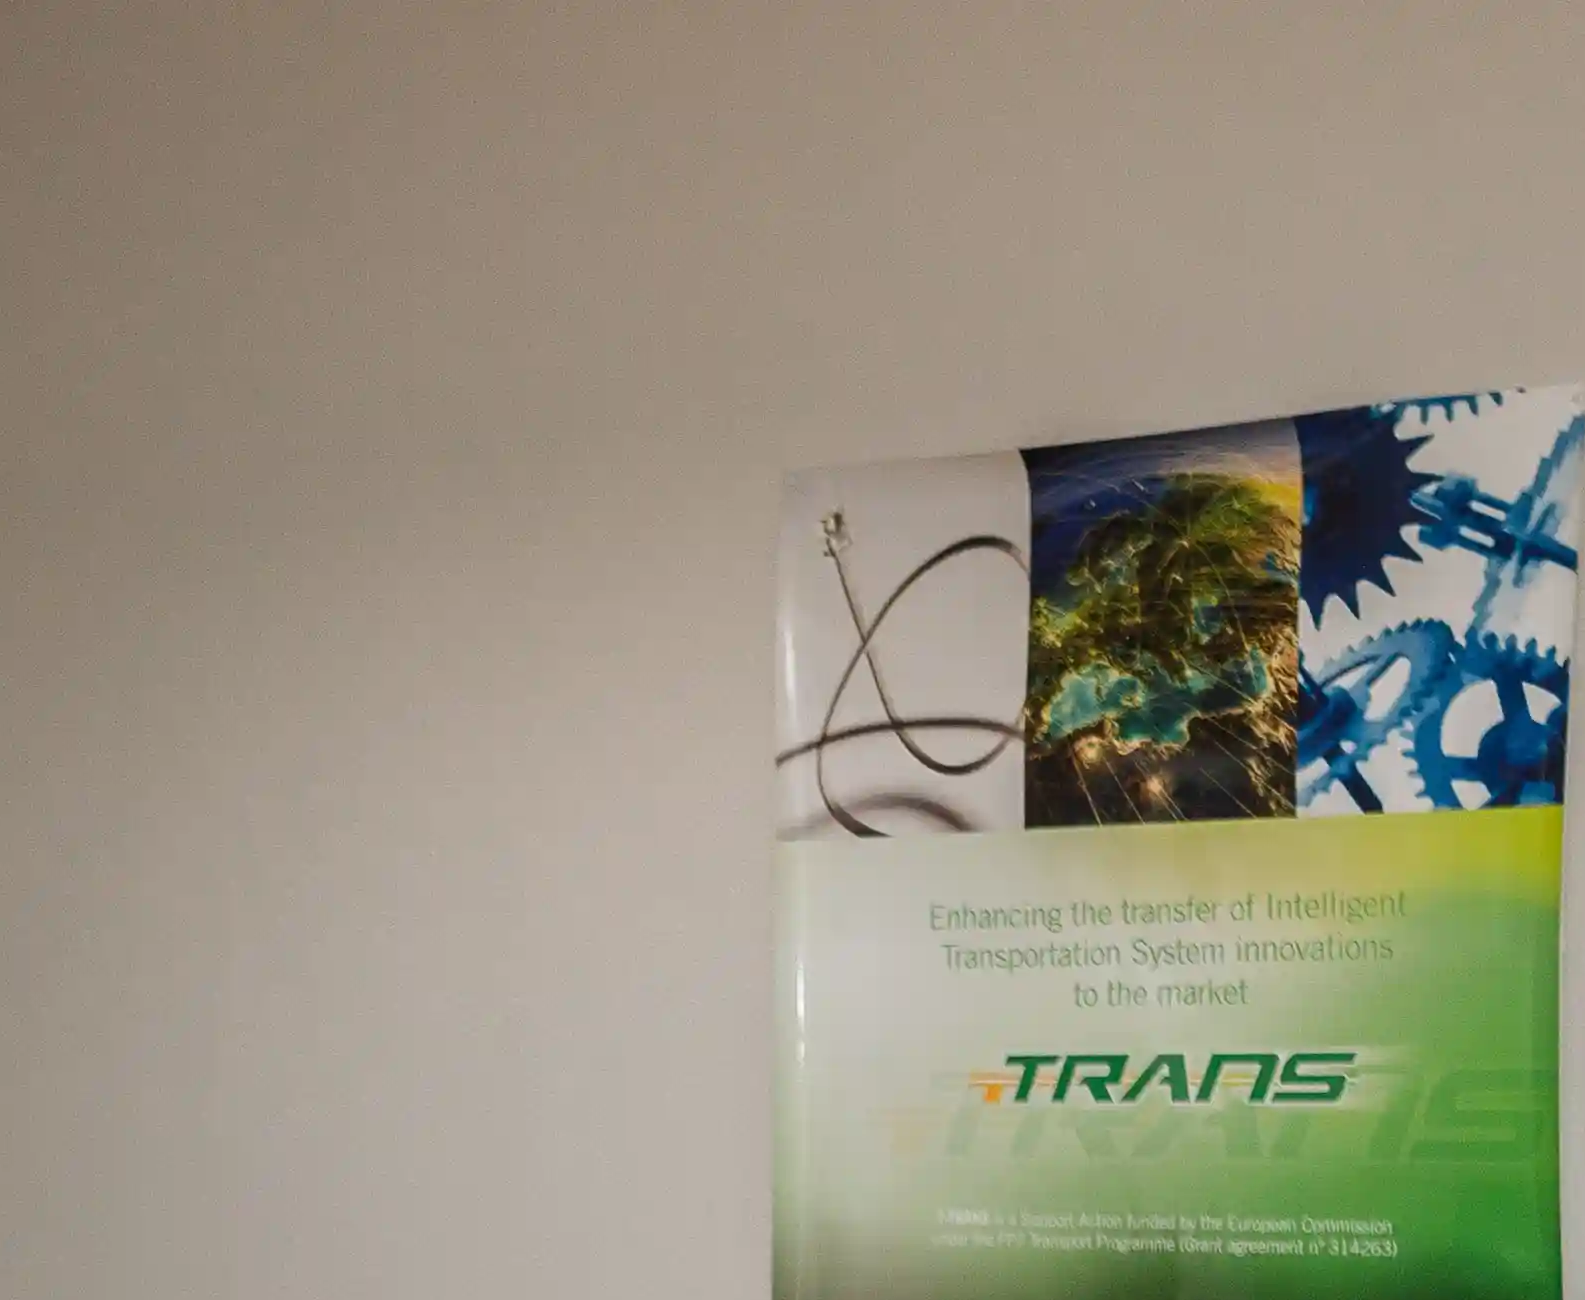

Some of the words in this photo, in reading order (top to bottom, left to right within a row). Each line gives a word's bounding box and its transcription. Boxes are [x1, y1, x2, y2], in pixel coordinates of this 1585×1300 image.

[930, 905, 1062, 933] Enhancing
[1070, 900, 1112, 928] the
[1121, 895, 1221, 925] transfer
[1230, 893, 1255, 922] of
[1267, 890, 1407, 925] Intelligent
[942, 940, 1120, 973] Transportation
[1132, 937, 1224, 969] System
[1235, 932, 1394, 967] innovations
[1074, 982, 1098, 1008] to
[1107, 980, 1147, 1008] the
[1158, 978, 1249, 1007] market
